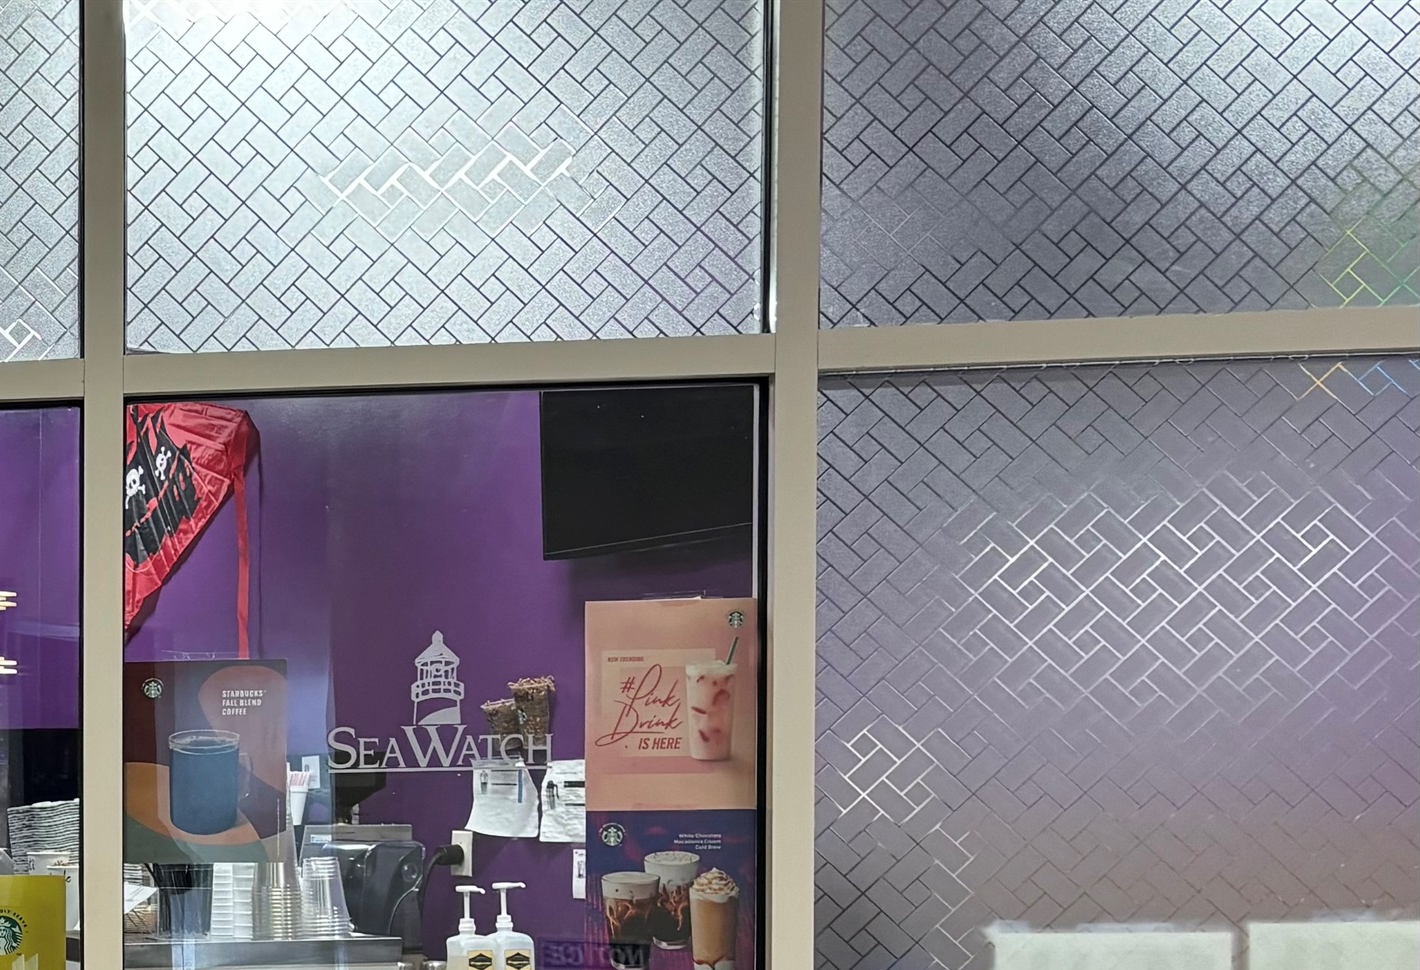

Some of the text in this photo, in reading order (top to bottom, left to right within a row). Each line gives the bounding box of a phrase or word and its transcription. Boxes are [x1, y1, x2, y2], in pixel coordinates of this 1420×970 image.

[222, 690, 264, 698] STARBUCKS
[222, 698, 262, 707] FALL BLEND
[222, 708, 247, 716] COFFEE
[595, 700, 683, 747] Drink
[638, 737, 682, 750] IS HERE
